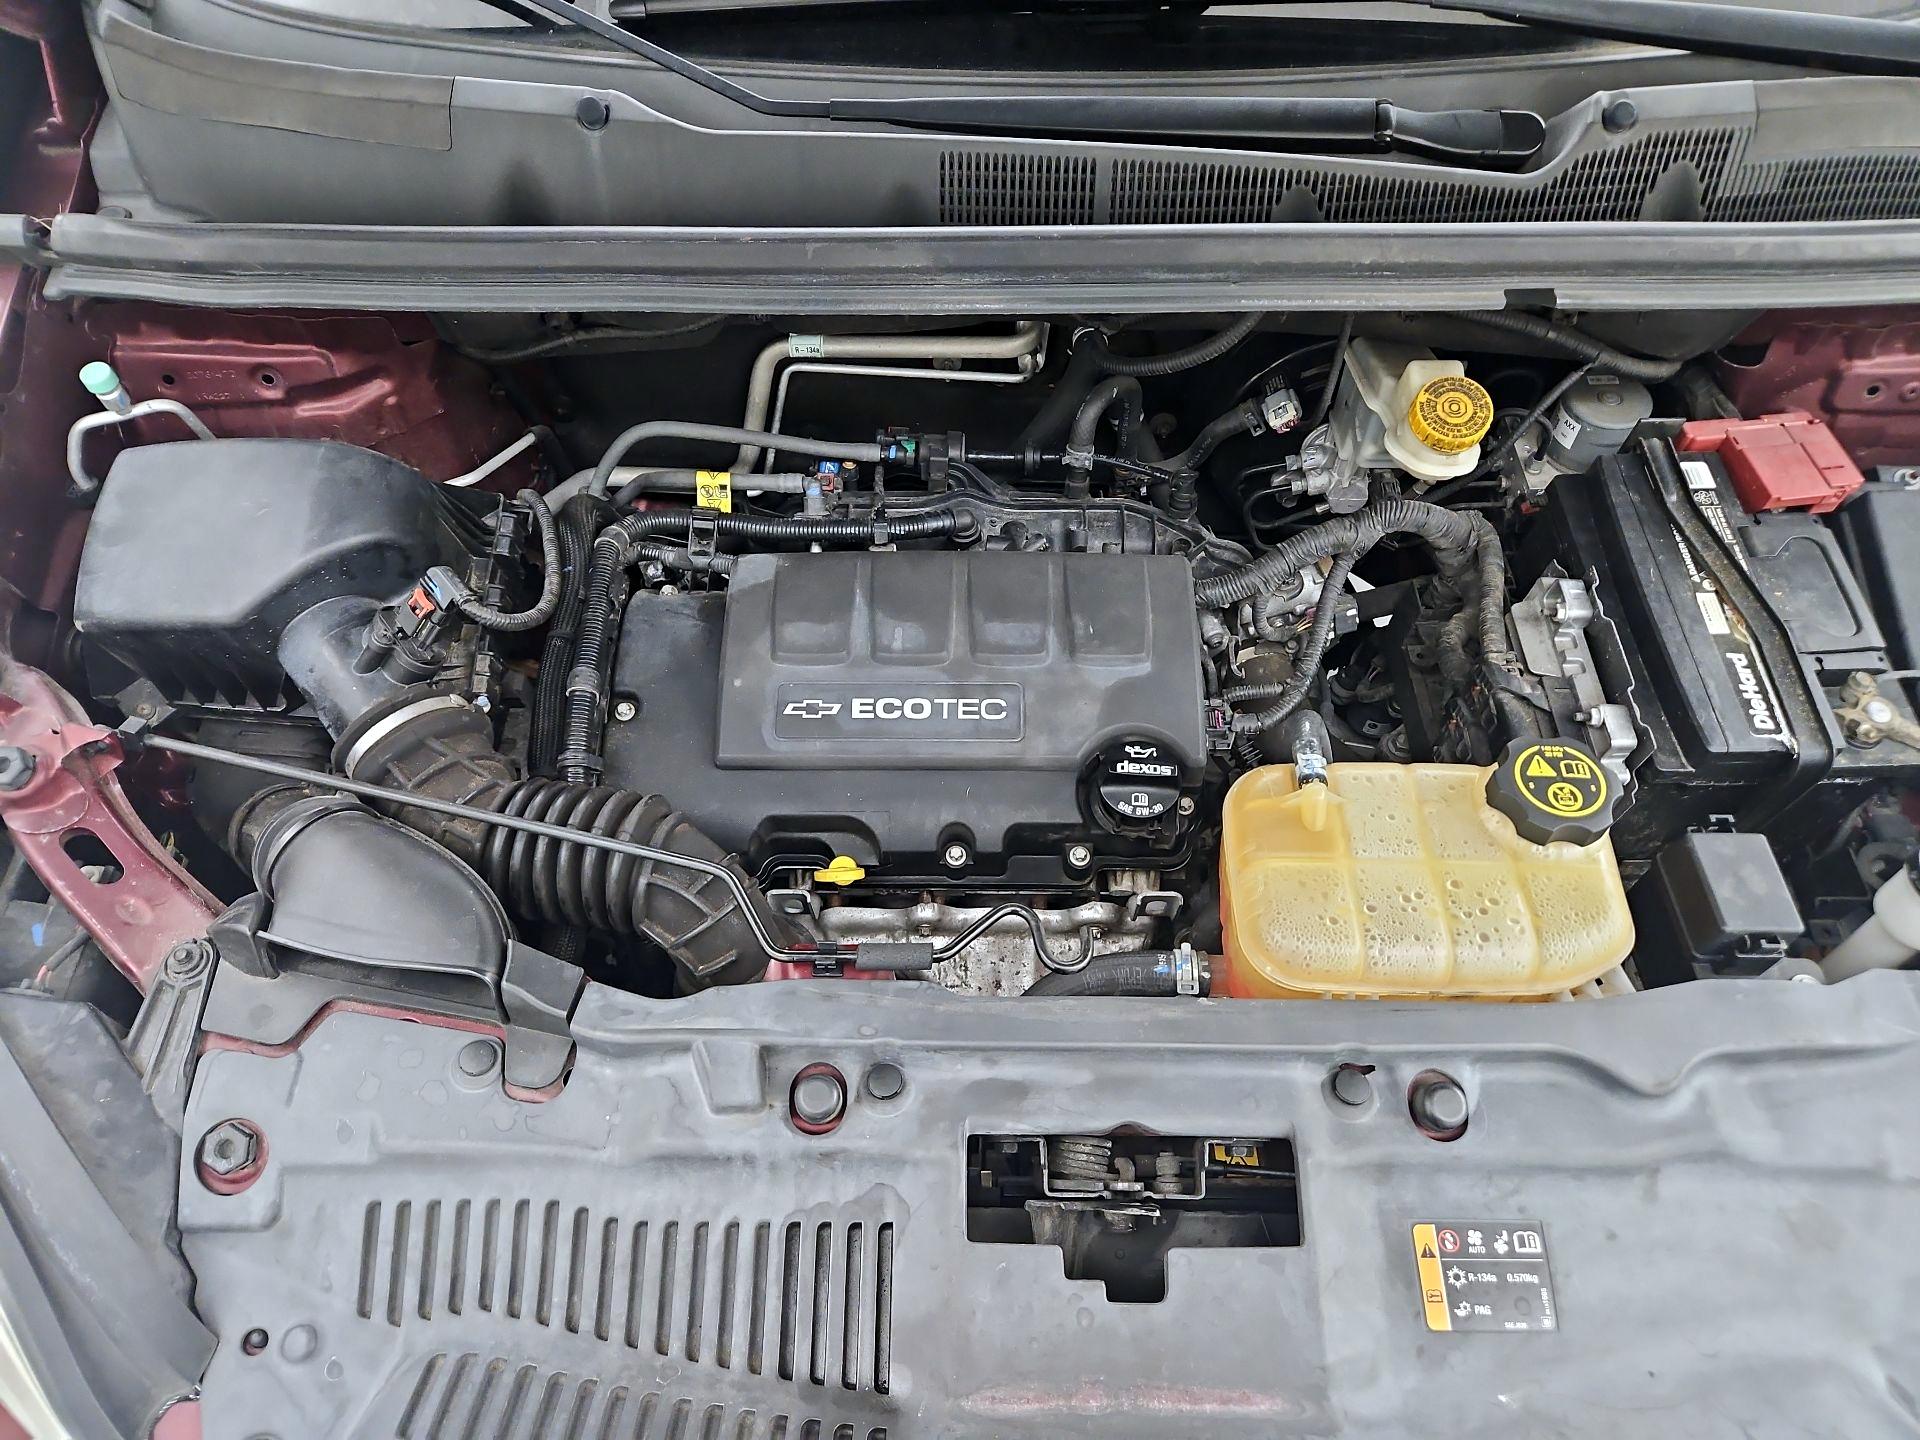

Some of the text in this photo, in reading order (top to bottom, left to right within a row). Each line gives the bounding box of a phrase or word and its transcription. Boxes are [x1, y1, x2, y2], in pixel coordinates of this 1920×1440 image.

[1563, 419, 1577, 432] AXX
[1725, 652, 1776, 730] DieHard
[851, 697, 1008, 720] ECOTEC
[1116, 760, 1175, 776] dexos
[1117, 801, 1164, 816] SAE 5W-30
[1468, 1245, 1486, 1254] AUTO
[1468, 1273, 1539, 1284] R-134a 0.570kg
[1474, 1305, 1492, 1315] PAG
